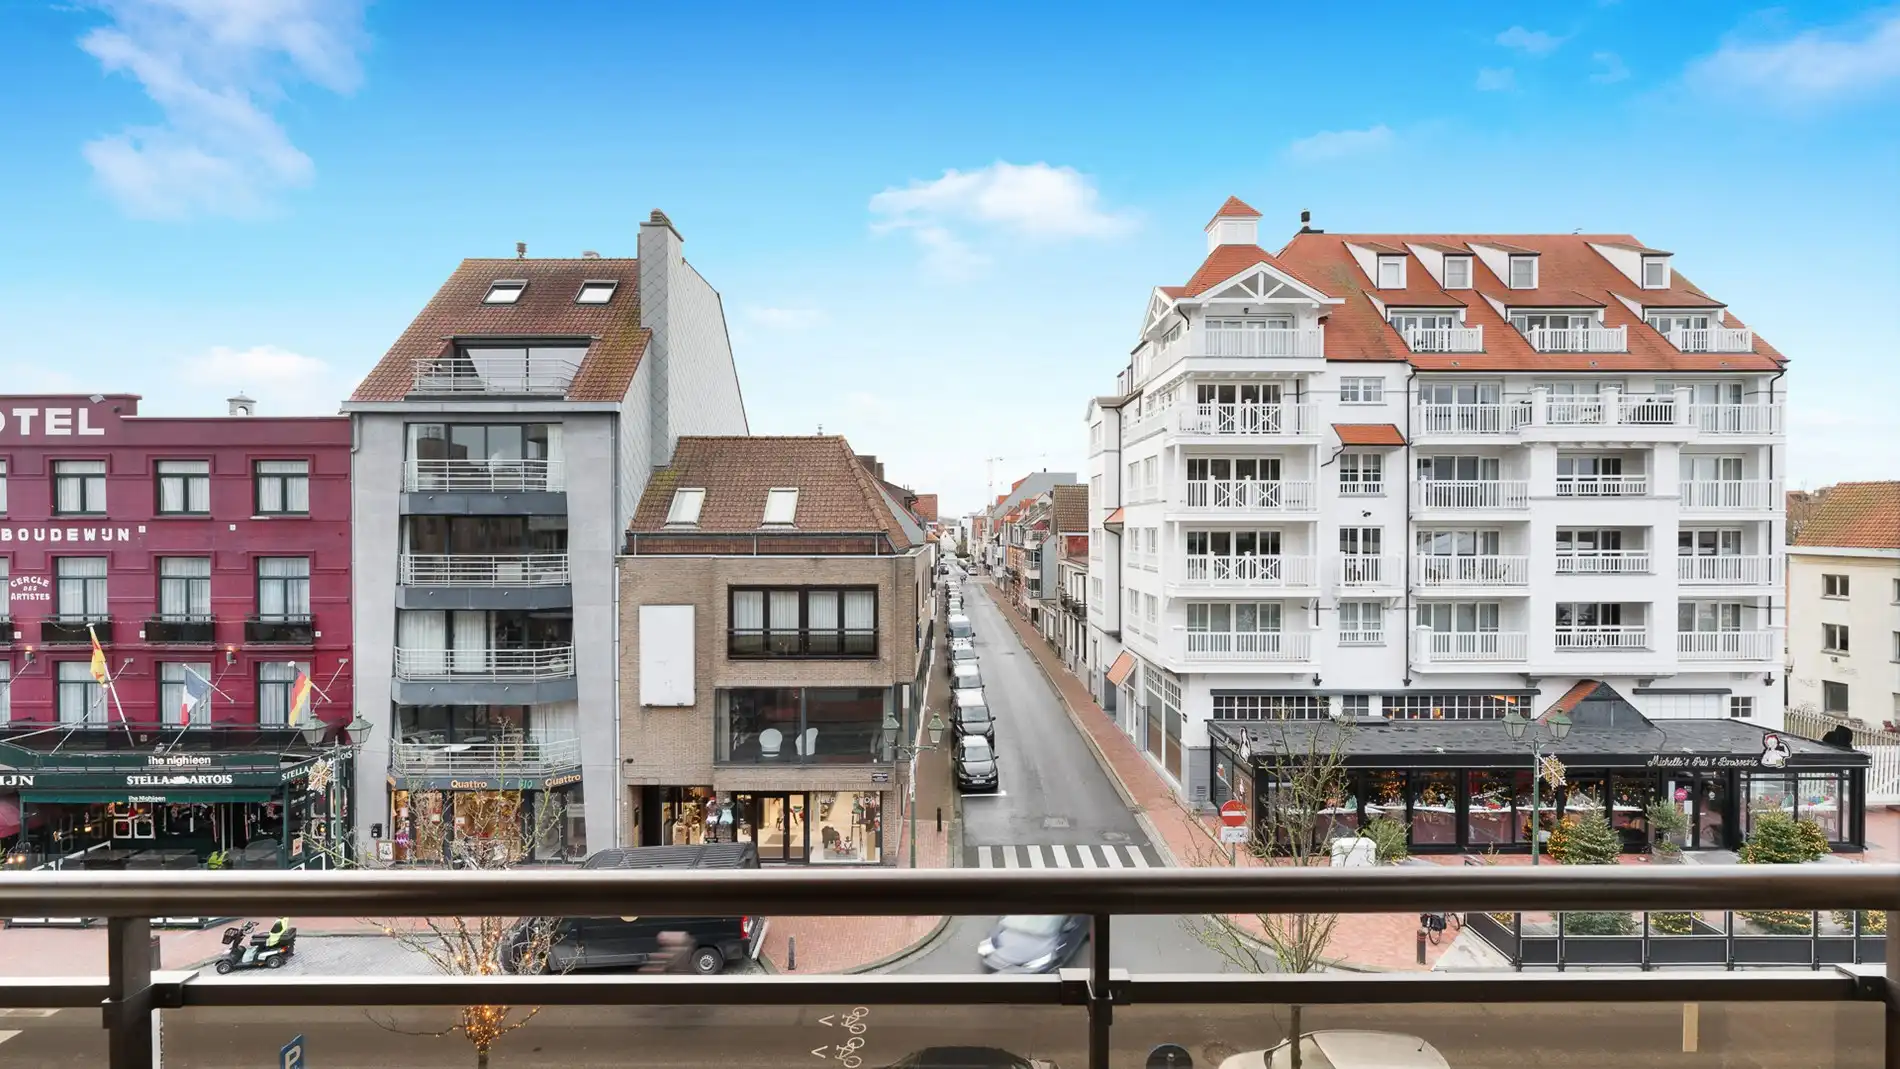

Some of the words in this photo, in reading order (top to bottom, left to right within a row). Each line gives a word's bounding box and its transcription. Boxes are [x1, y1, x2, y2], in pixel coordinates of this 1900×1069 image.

[0, 407, 105, 436] TEL
[10, 576, 50, 588] CERCLE
[10, 592, 50, 601] ARTISTES
[1647, 755, 1689, 767] Michelle's
[1692, 756, 1709, 767] Pub
[1717, 757, 1759, 767] Brasserie
[281, 765, 311, 781] STELLA
[126, 775, 170, 785] STELLA
[187, 774, 233, 785] ARTOIS
[450, 779, 488, 789] Quattro
[544, 773, 581, 788] Quattro
[285, 1045, 301, 1069] P
